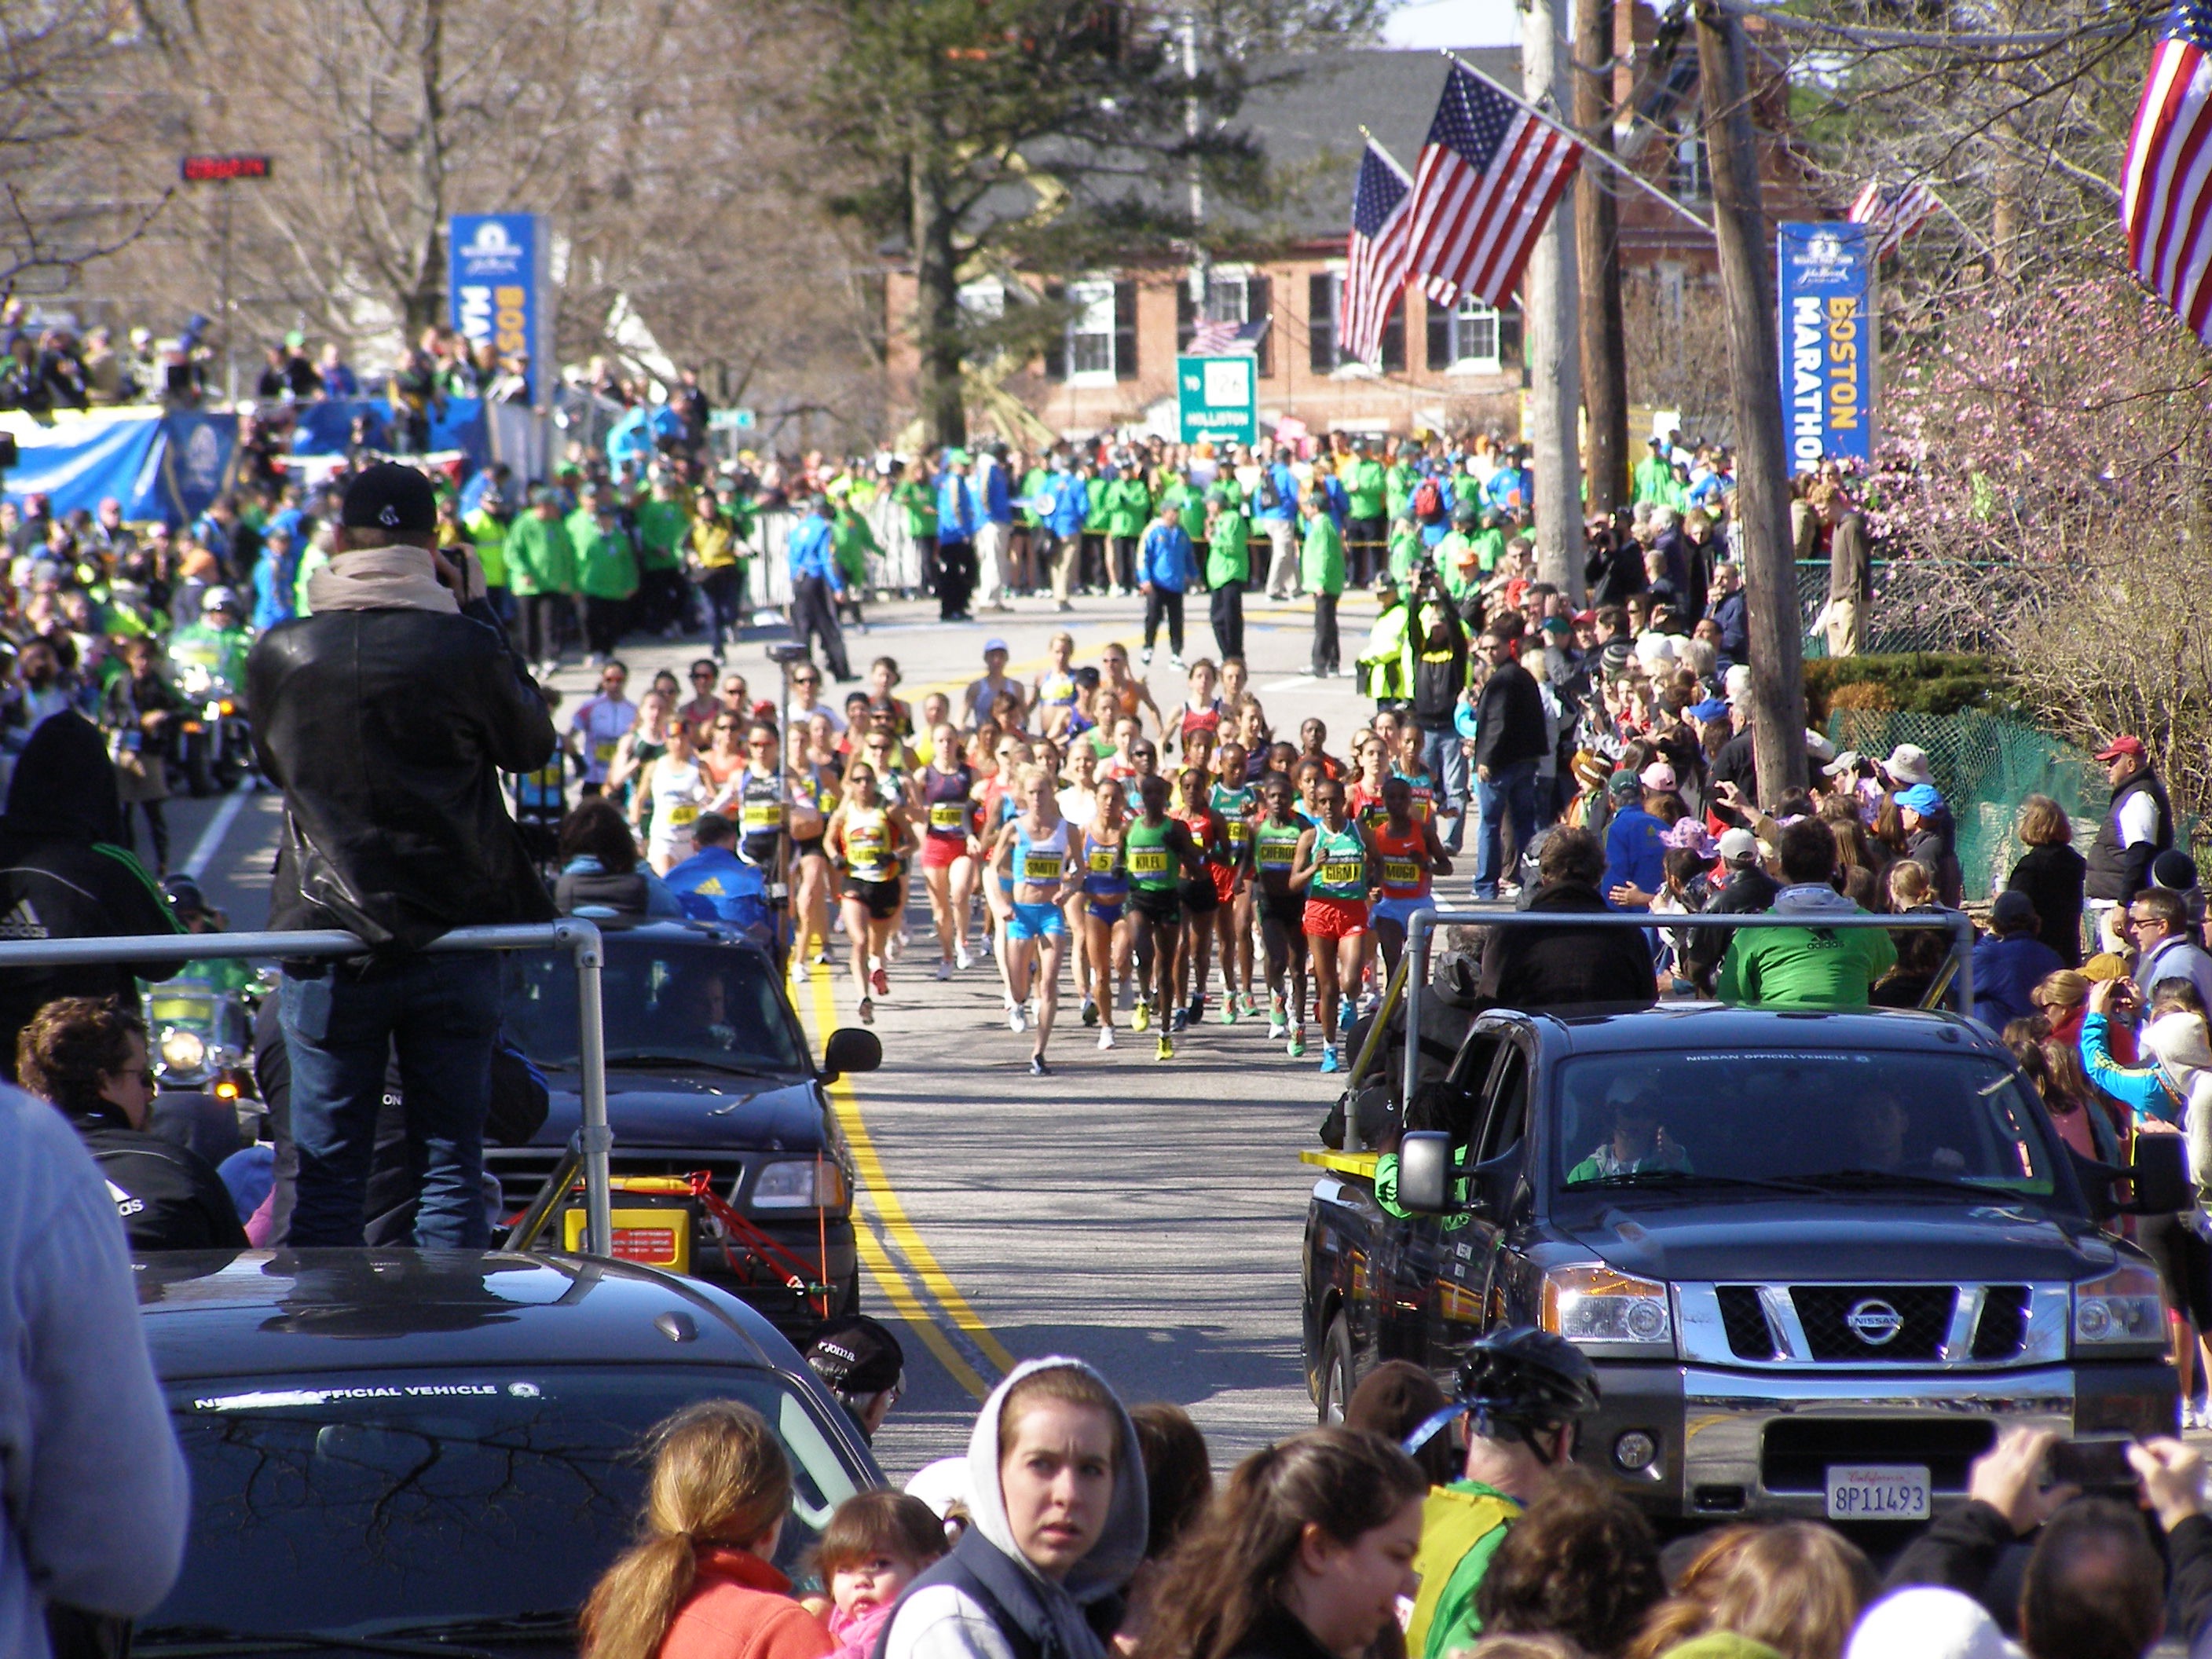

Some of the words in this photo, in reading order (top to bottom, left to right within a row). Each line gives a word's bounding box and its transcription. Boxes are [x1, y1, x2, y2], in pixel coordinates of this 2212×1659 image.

[1828, 296, 1858, 430] BOSTON
[1099, 855, 1109, 868] 5
[1135, 855, 1160, 870] KILEL
[1386, 864, 1416, 879] MUGO
[300, 1387, 402, 1404] OFFICIAL
[404, 1384, 498, 1397] VEHICLE
[1848, 1471, 1909, 1486] California
[1835, 1486, 1925, 1512] 8P11493
